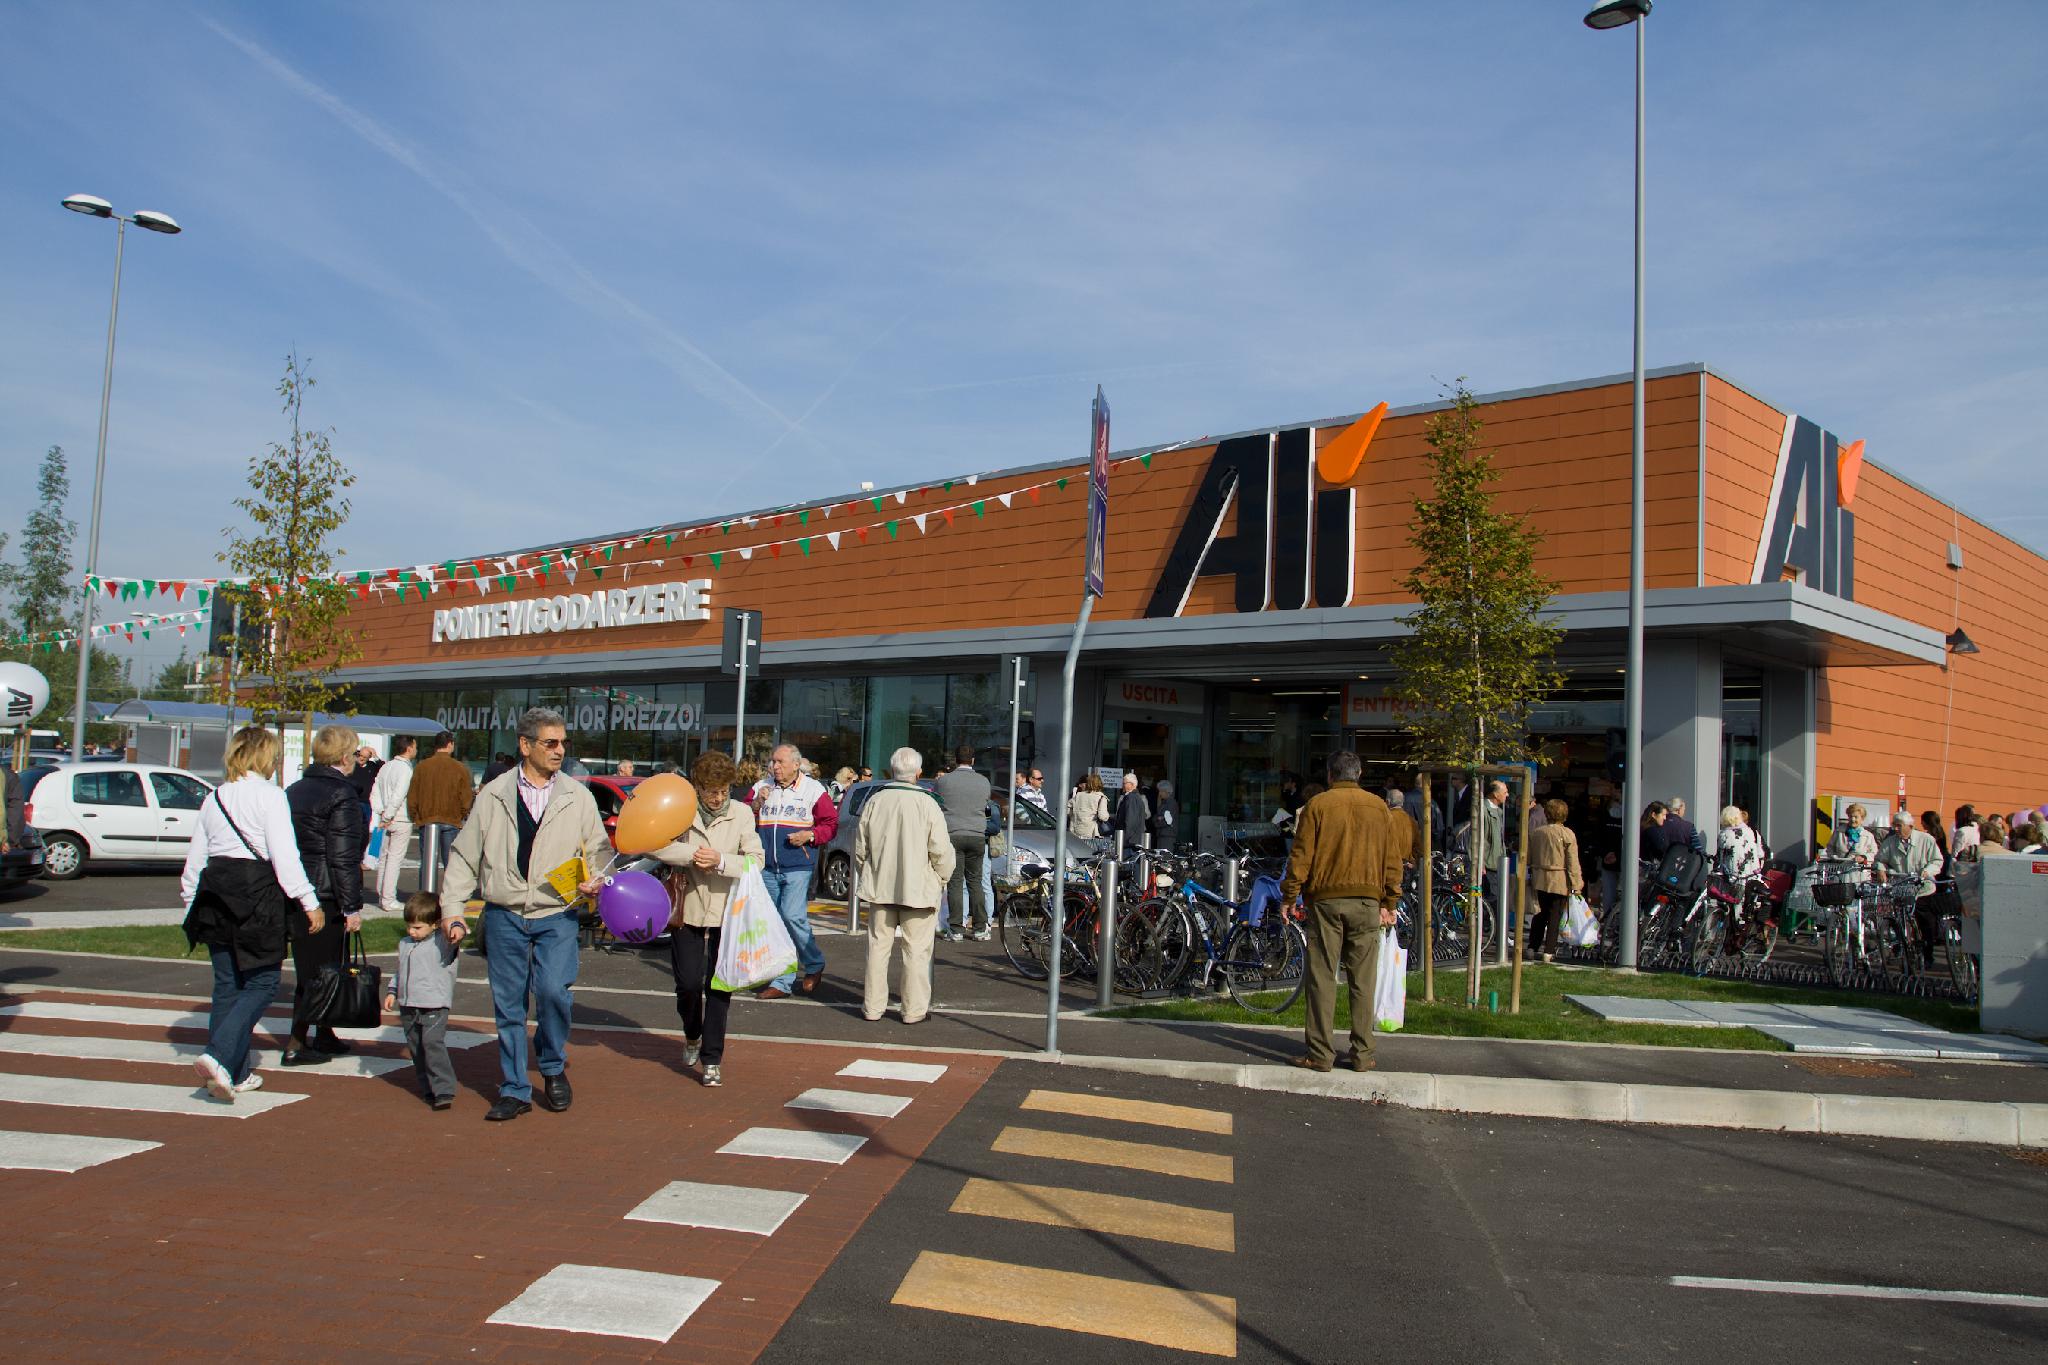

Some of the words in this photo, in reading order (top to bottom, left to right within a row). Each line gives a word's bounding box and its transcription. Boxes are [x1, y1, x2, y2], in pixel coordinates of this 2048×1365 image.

[432, 579, 712, 642] PONTEVIGODARZERE
[1122, 682, 1178, 704] USCITA
[436, 701, 500, 730] QUALITÀ
[610, 703, 700, 731] PREZZO!
